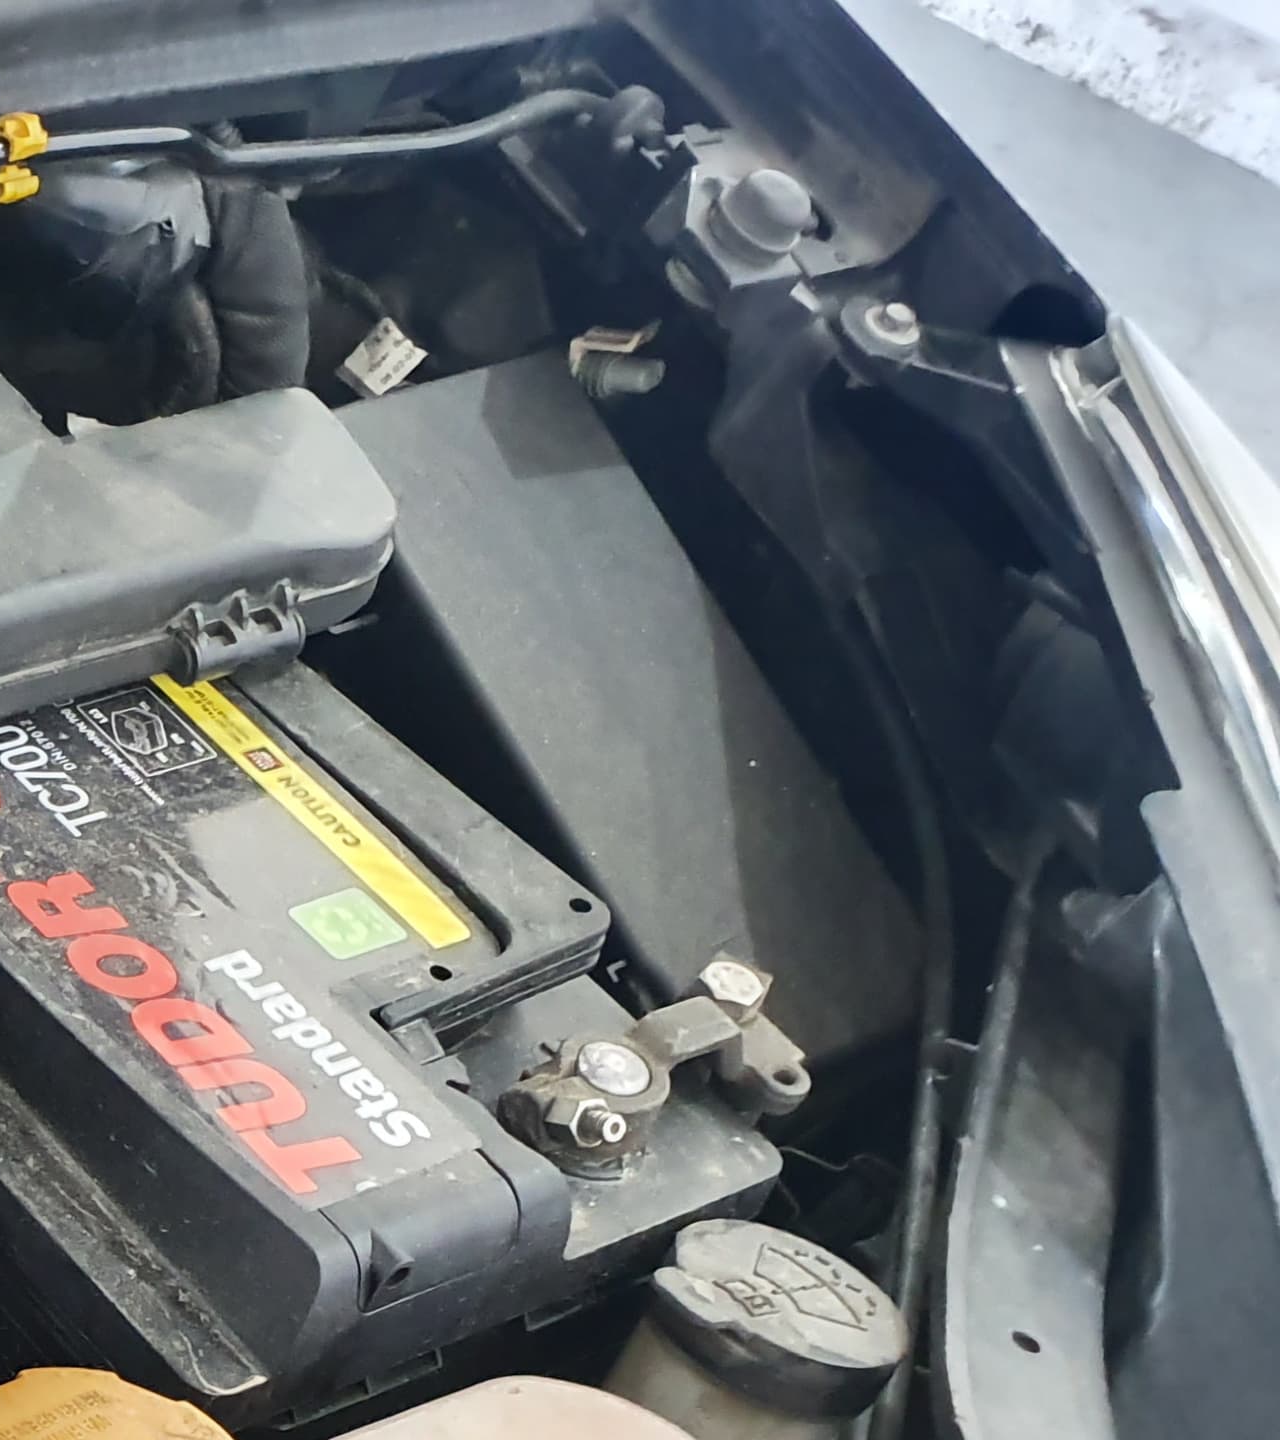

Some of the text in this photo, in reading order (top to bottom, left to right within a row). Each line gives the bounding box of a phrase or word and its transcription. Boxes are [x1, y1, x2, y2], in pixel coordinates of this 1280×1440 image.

[277, 775, 361, 847] CAUTION
[7, 871, 361, 1195] TUDOR
[205, 949, 431, 1147] Standard
